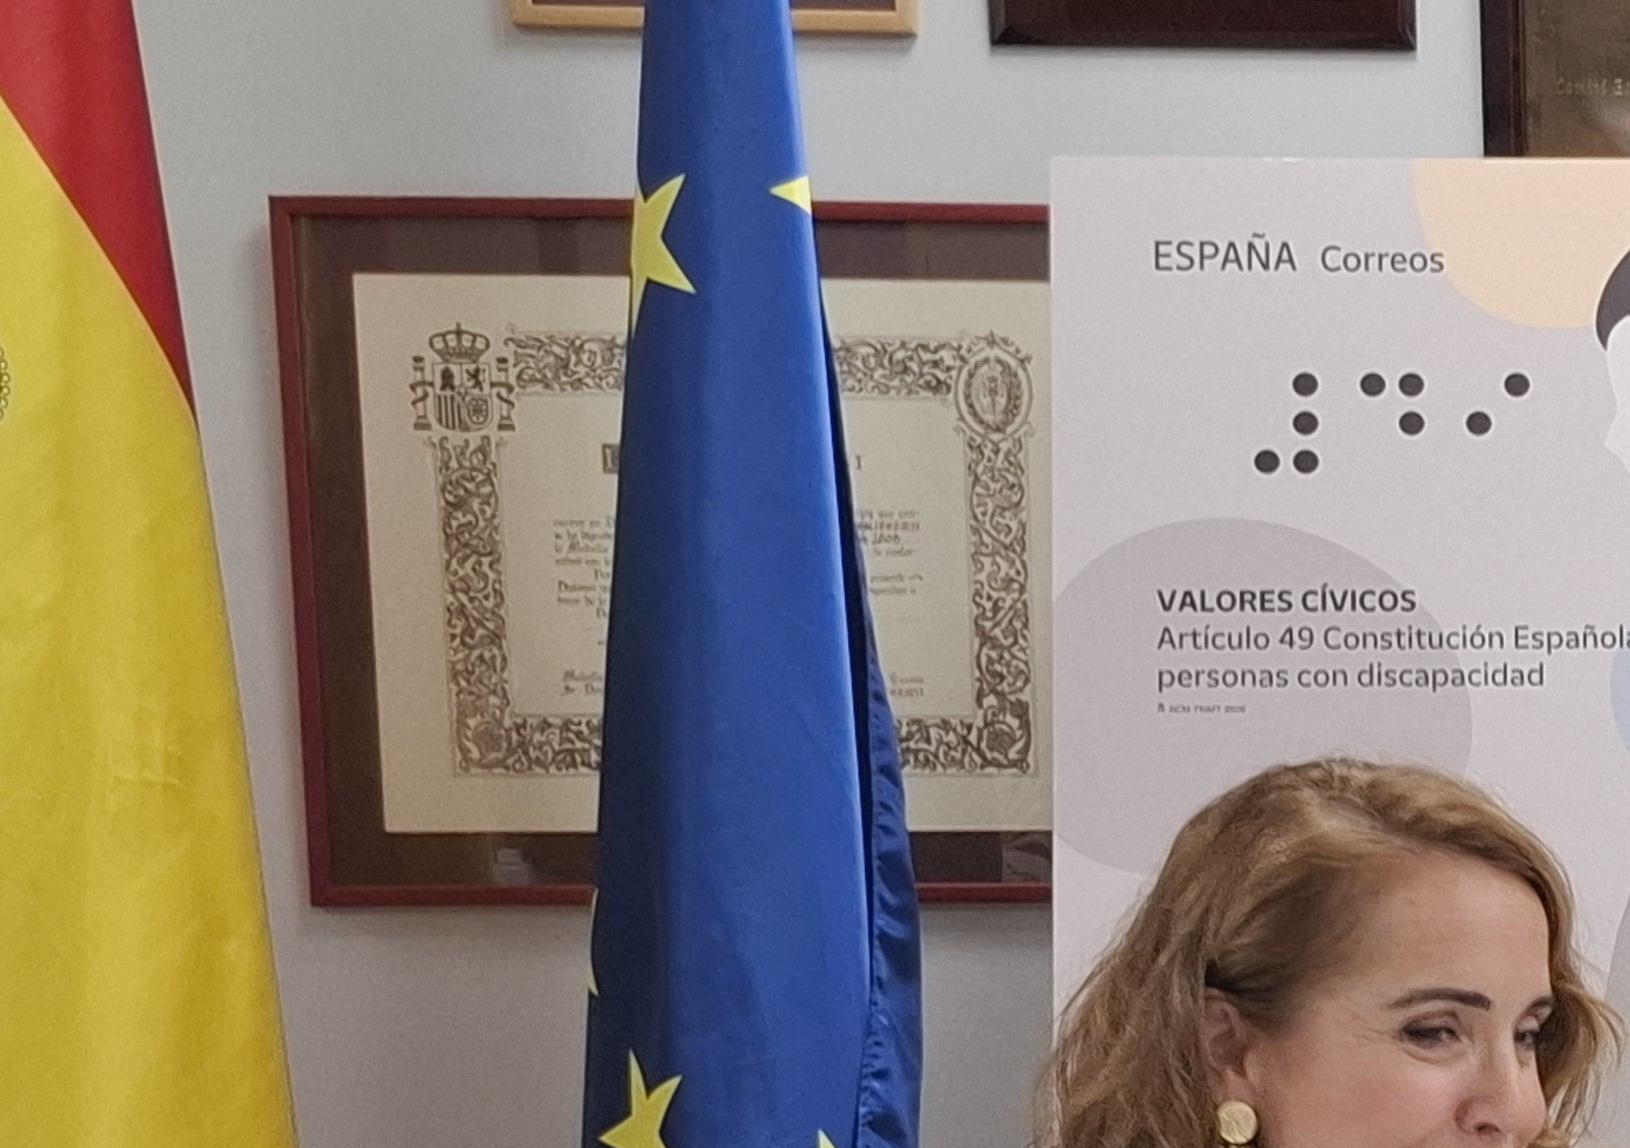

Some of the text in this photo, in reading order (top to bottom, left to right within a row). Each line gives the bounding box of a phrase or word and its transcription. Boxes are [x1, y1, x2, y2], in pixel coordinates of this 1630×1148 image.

[1153, 231, 1445, 274] ESPAÑA Correos
[1156, 582, 1417, 614] VALORES CÍVICOS
[1156, 623, 1271, 651] Artículo
[1278, 625, 1315, 651] 49
[1323, 623, 1505, 651] Constitución
[1157, 661, 1545, 695] personas con discapacidad
